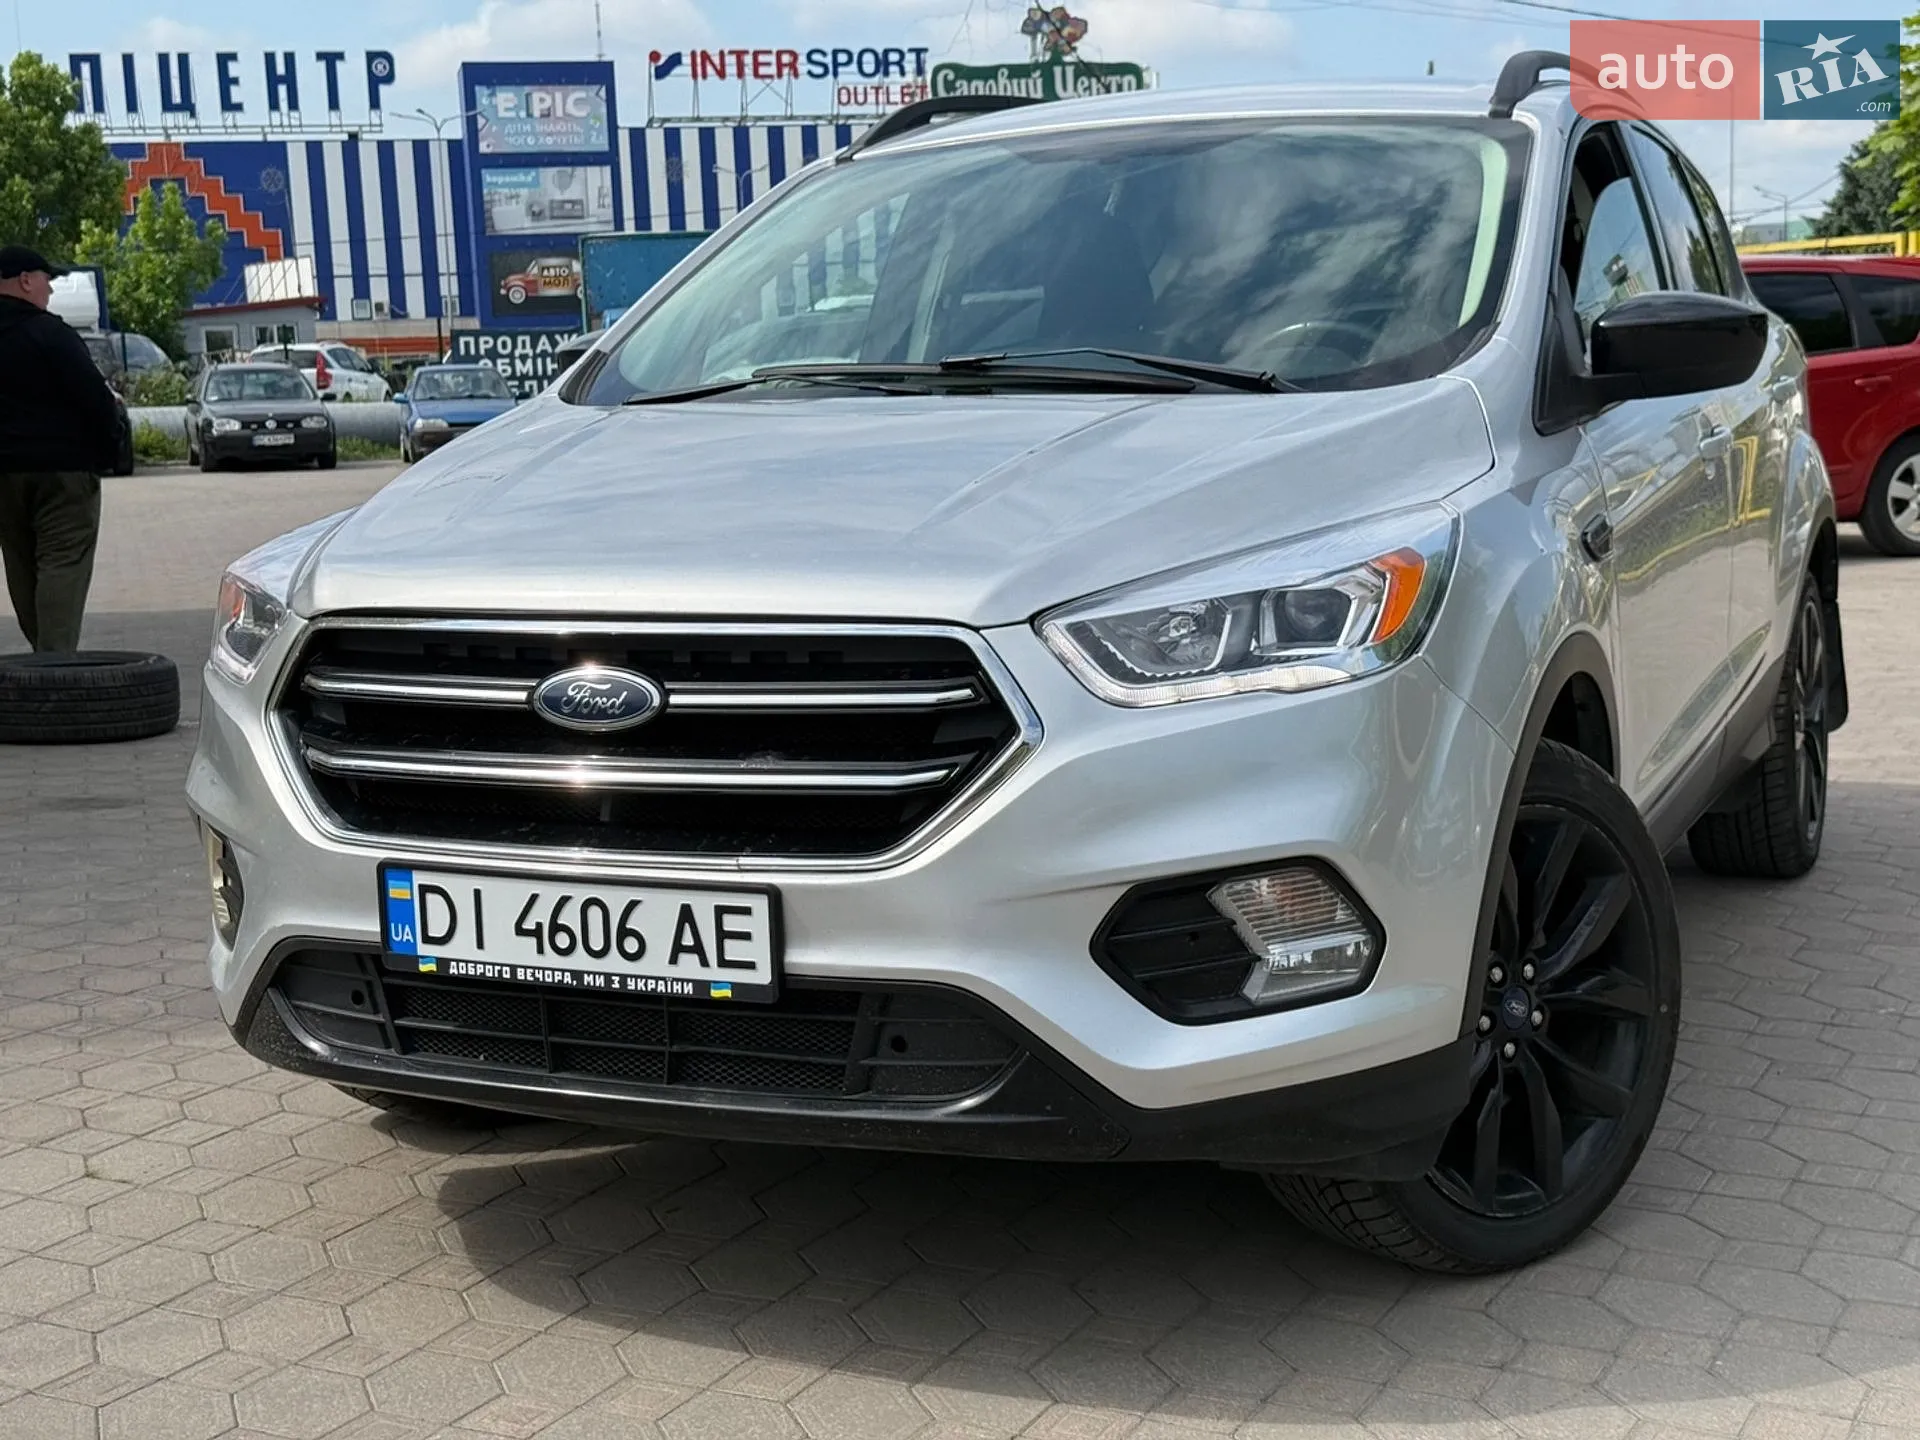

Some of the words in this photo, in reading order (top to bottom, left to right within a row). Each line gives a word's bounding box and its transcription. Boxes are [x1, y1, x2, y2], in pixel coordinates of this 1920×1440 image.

[836, 84, 929, 107] OUTLET
[542, 266, 569, 277] АВТО
[542, 278, 570, 288] МОЛ
[560, 681, 628, 715] Ford
[390, 922, 414, 944] UA
[418, 883, 485, 950] DI
[514, 892, 647, 962] 4606
[668, 902, 759, 971] AE
[449, 960, 511, 980] ДОБРОГО
[516, 967, 578, 987] ВЕЧОРА,
[583, 974, 605, 988] МИ
[626, 977, 694, 995] УКРАЇНИ
